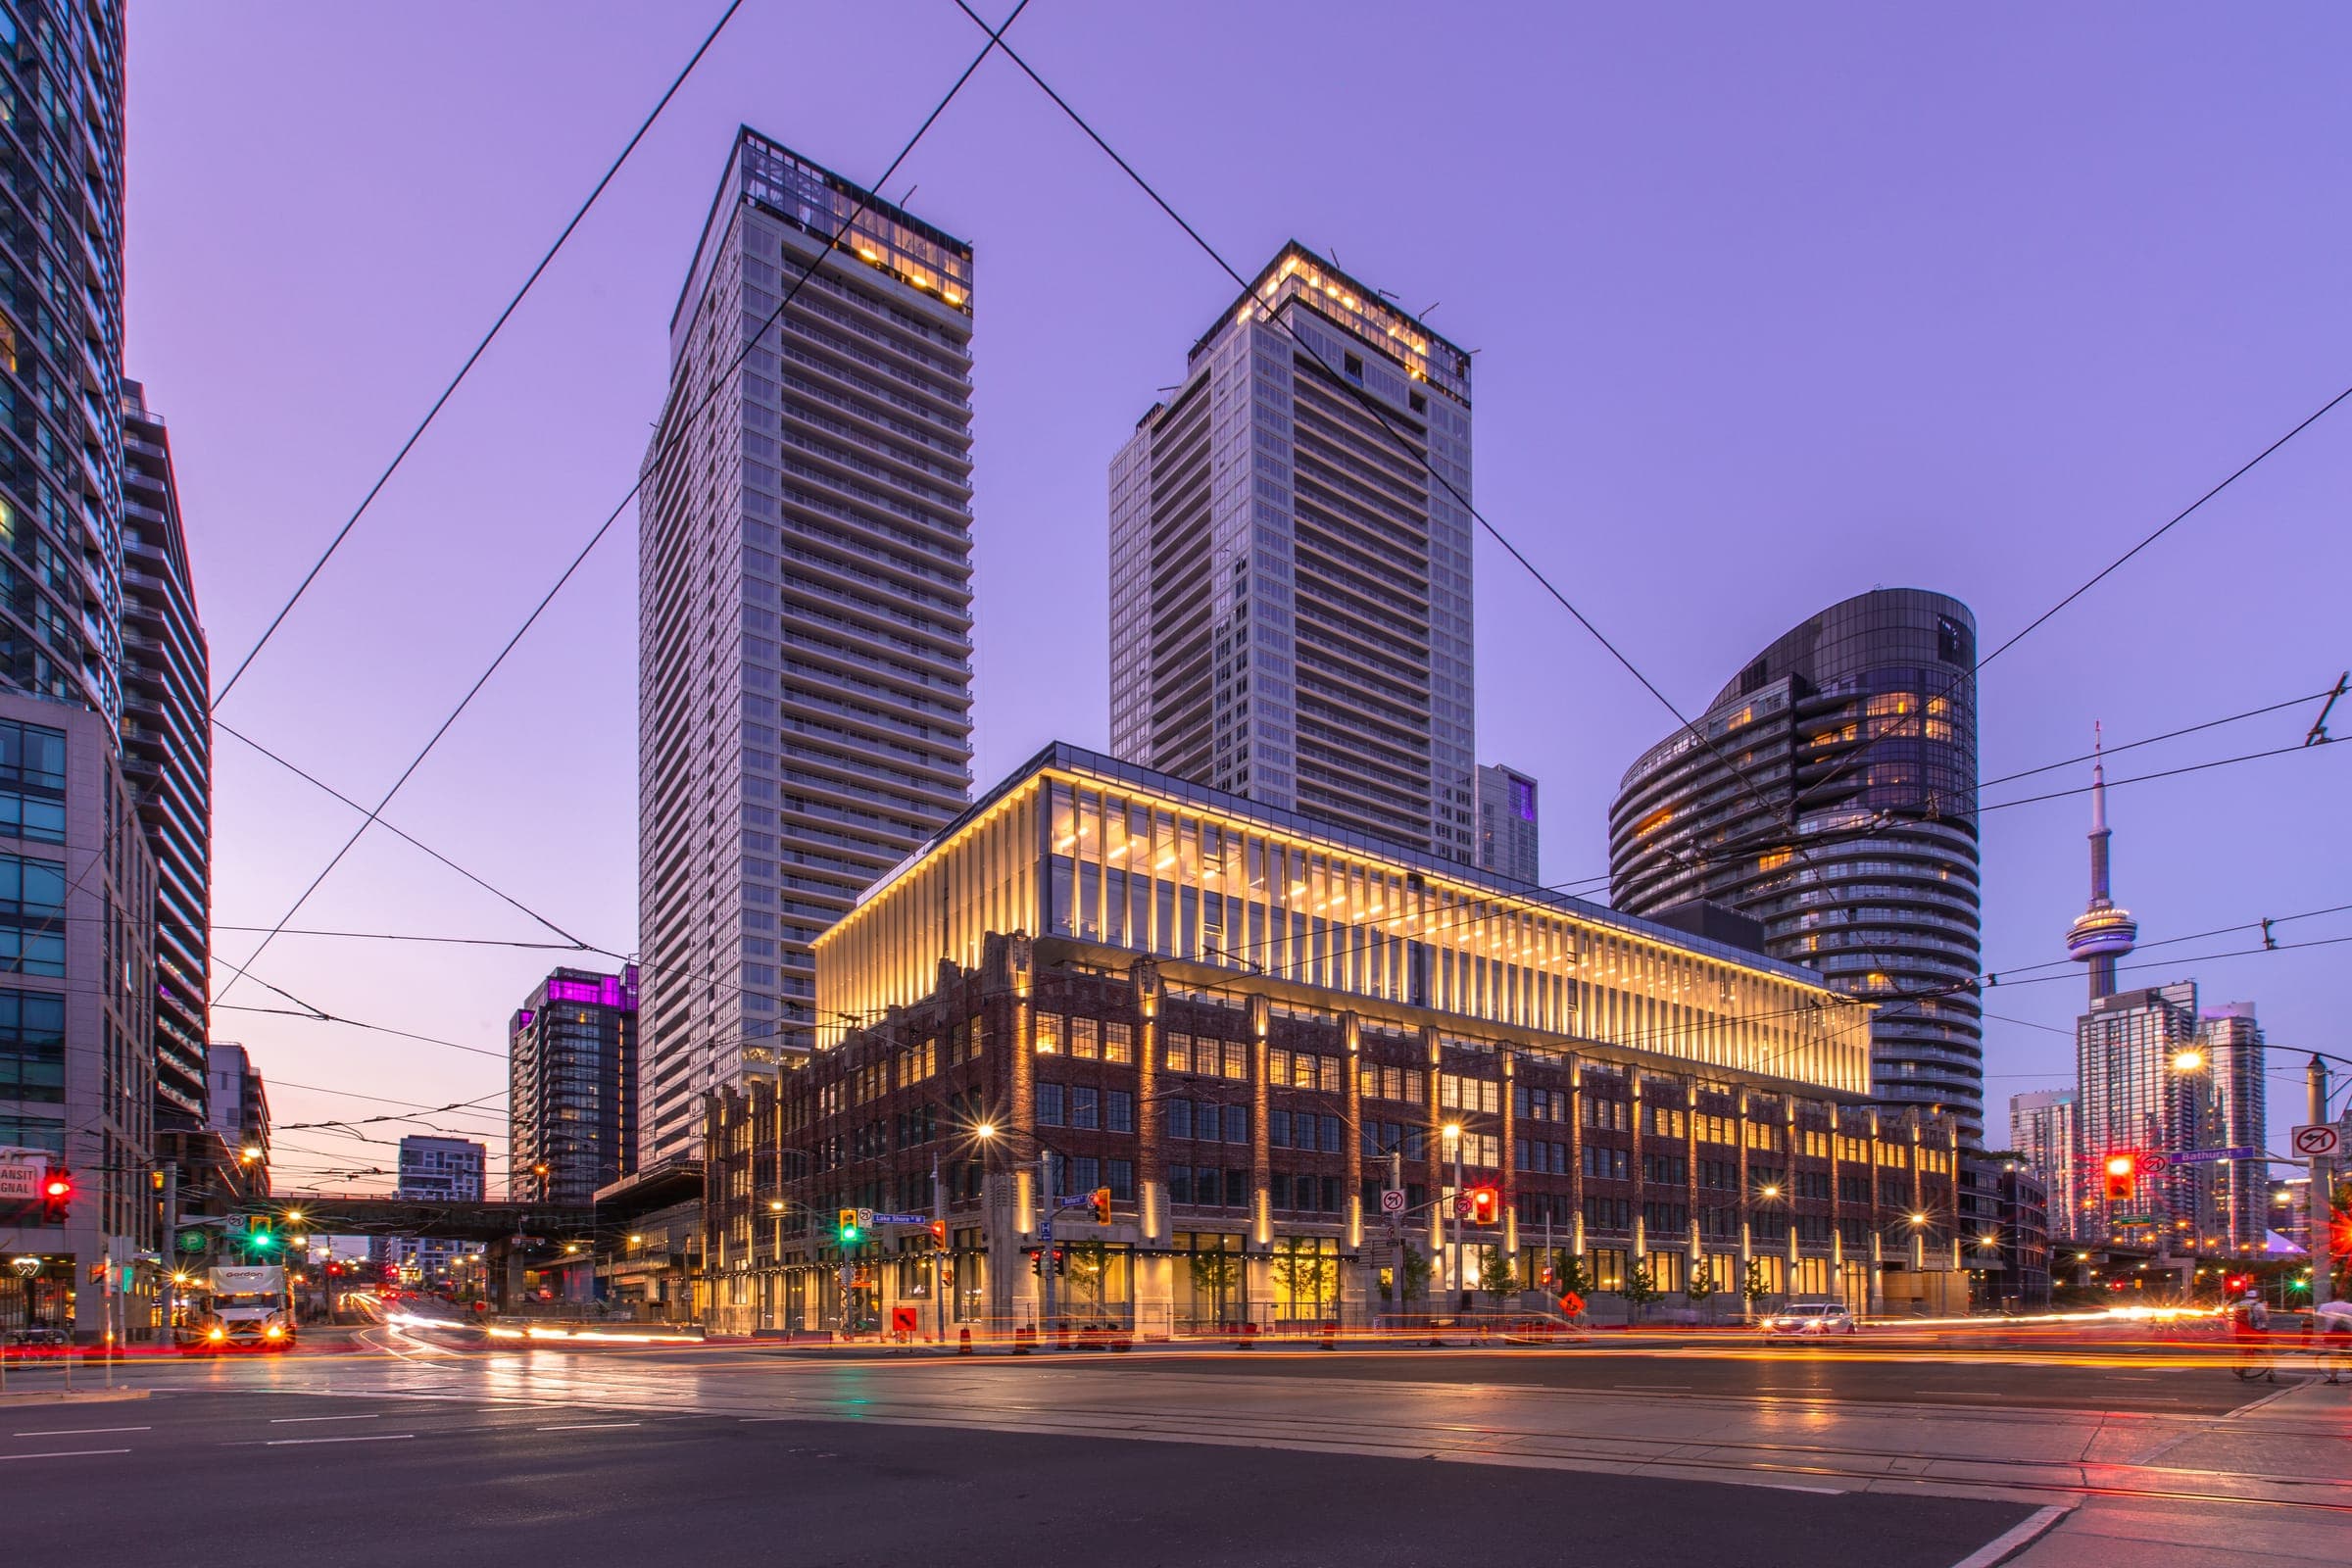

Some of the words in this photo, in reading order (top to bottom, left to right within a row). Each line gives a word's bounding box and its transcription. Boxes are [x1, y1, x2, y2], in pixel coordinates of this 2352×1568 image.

[2182, 1150, 2232, 1161] Bathurst
[1042, 1224, 1050, 1233] H
[187, 1237, 199, 1247] P
